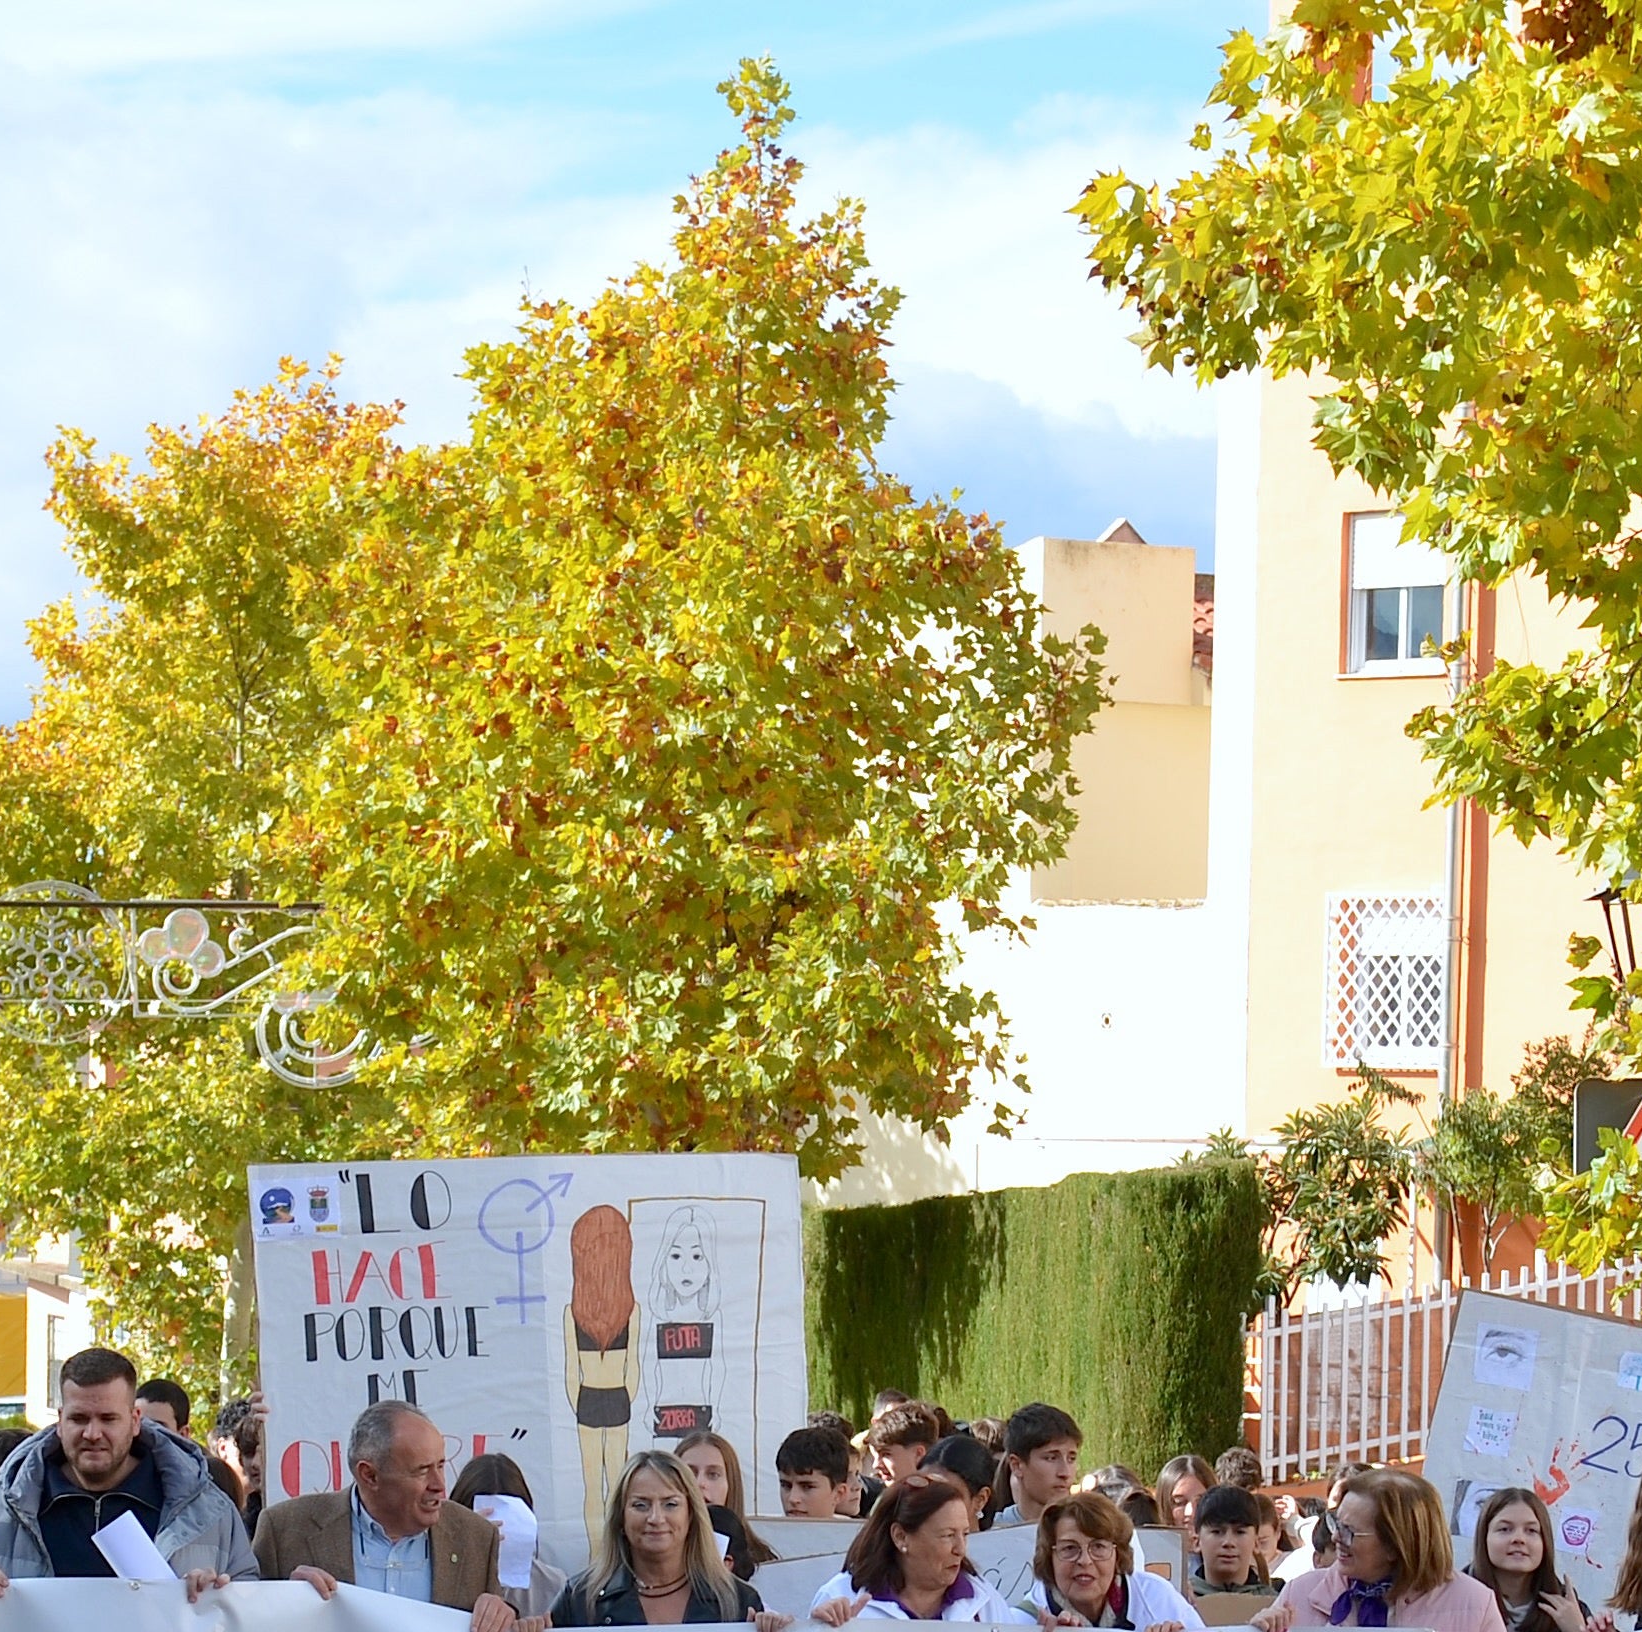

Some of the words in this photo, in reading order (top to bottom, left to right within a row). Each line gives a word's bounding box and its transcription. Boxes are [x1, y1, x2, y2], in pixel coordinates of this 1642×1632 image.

[311, 1240, 452, 1305] HACE
[304, 1306, 490, 1362] PORQUE
[664, 1325, 701, 1352] PUTA
[367, 1369, 429, 1407] ME
[658, 1409, 695, 1430] ZORRA
